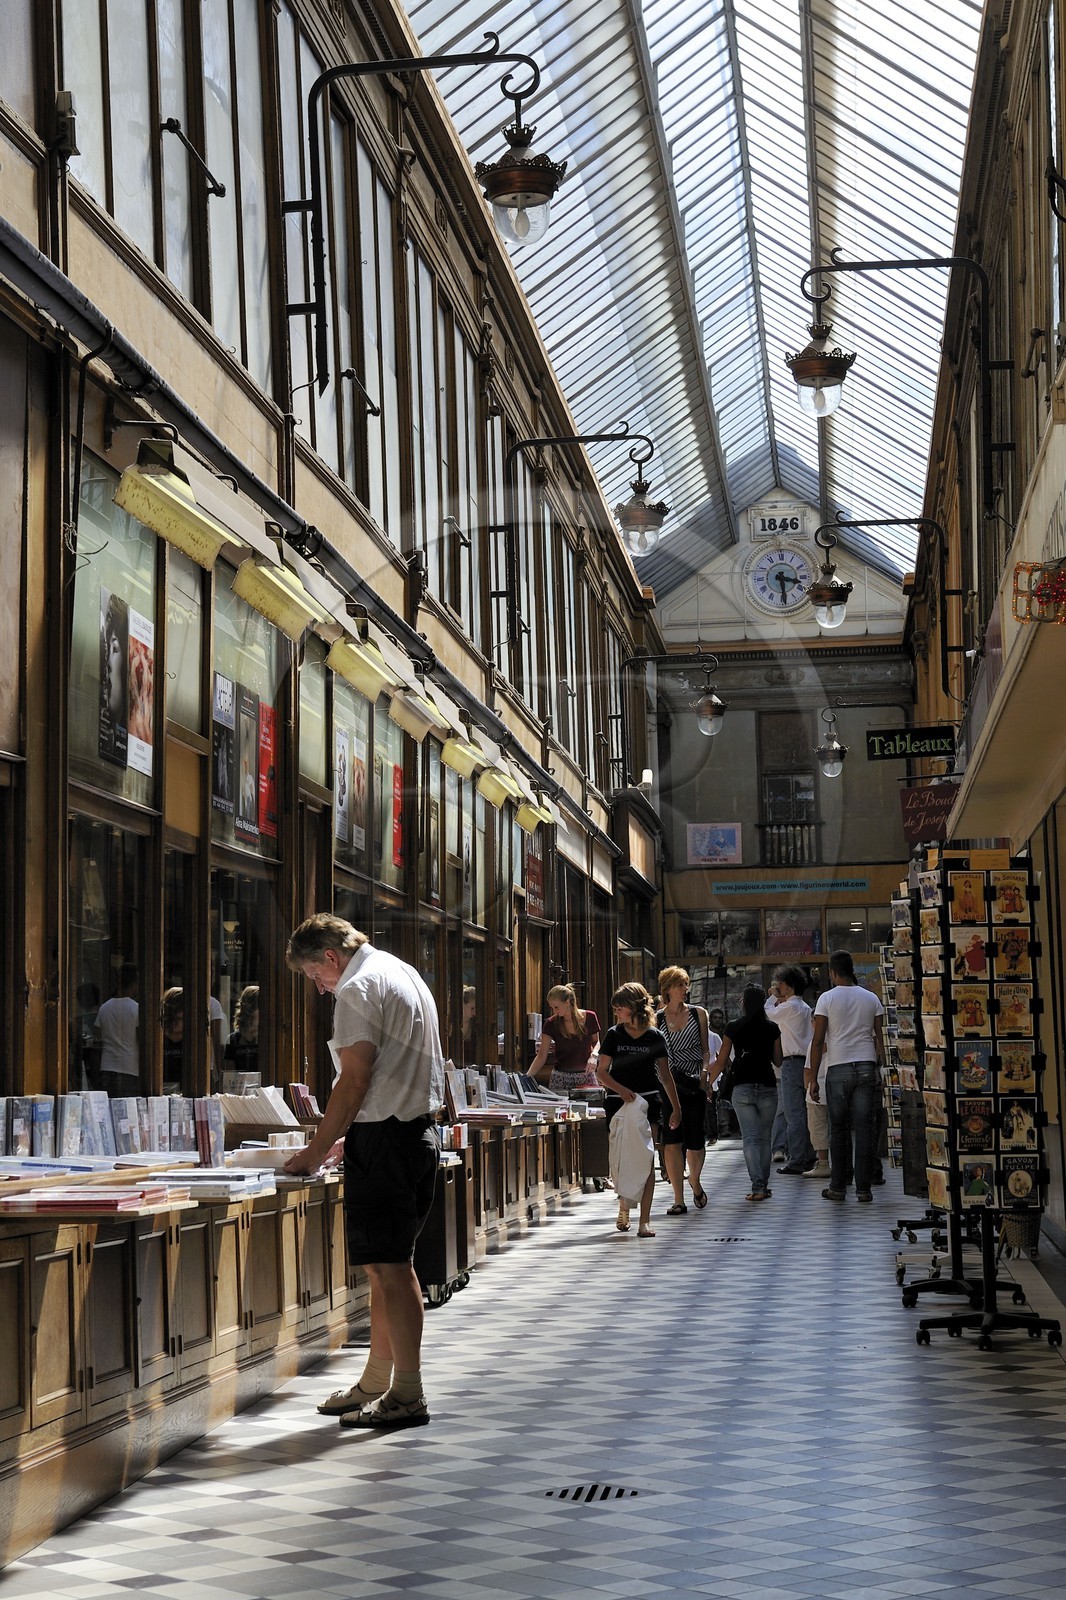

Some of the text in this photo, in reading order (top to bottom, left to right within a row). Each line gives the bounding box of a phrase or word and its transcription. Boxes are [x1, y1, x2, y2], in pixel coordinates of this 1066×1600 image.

[760, 517, 799, 531] 1846
[868, 733, 953, 756] Tableaux
[904, 789, 960, 809] Le Boud
[903, 811, 948, 834] de Josép
[715, 883, 777, 892] www.joujoux.com
[616, 1045, 650, 1054] BACKROADS
[960, 1105, 990, 1117] LE CHAT
